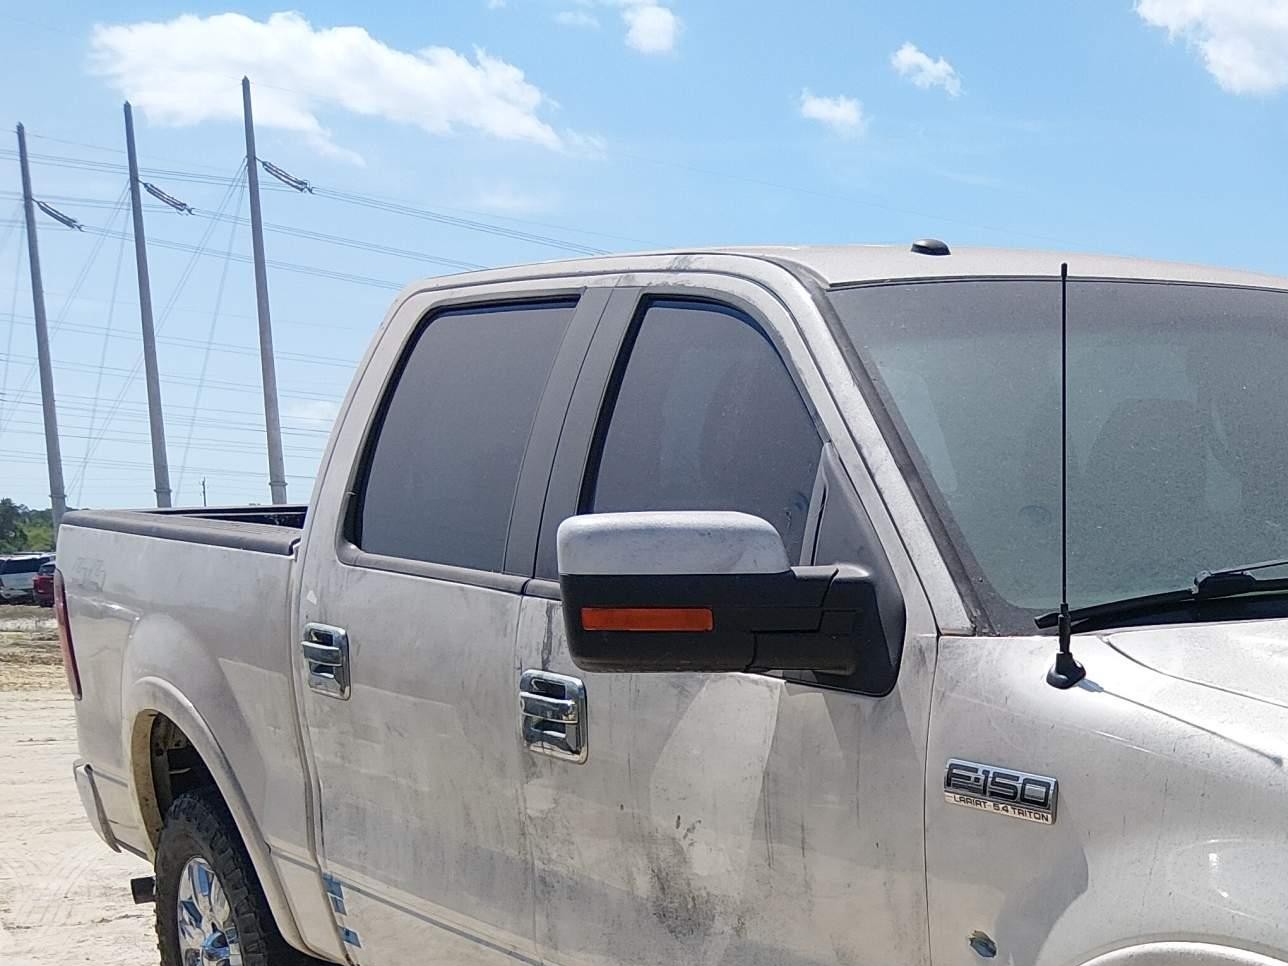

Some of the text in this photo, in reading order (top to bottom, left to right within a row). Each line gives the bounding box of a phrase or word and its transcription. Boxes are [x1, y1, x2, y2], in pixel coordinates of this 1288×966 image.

[946, 763, 1052, 810] F-150
[953, 795, 988, 809] LARIAT
[1011, 807, 1050, 822] TRITON
